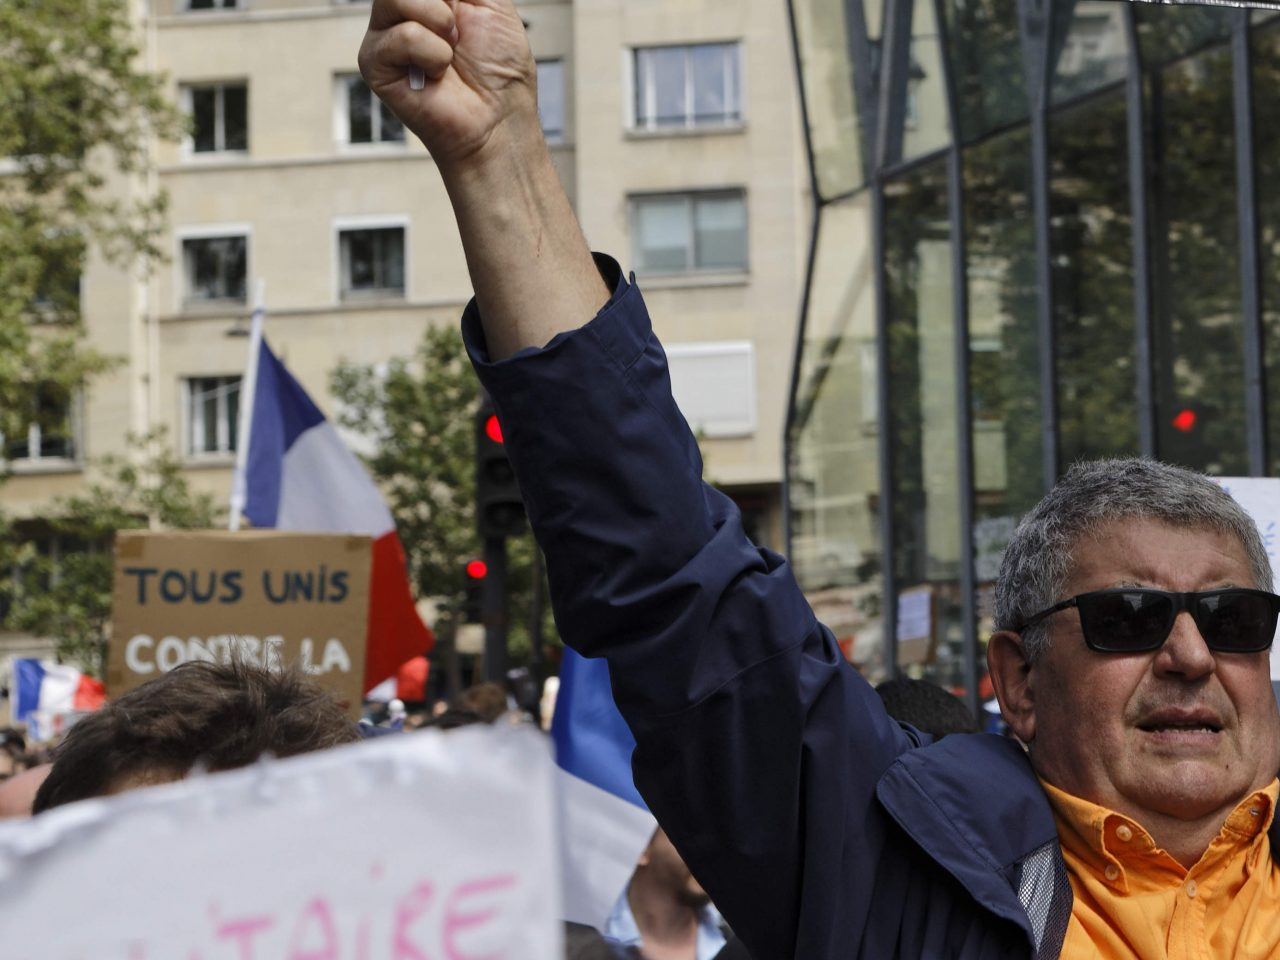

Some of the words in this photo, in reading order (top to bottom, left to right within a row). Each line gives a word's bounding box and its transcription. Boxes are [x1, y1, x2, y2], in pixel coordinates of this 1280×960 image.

[124, 567, 243, 605] TOUS
[125, 634, 285, 674] CONTRE
[301, 638, 350, 675] LA
